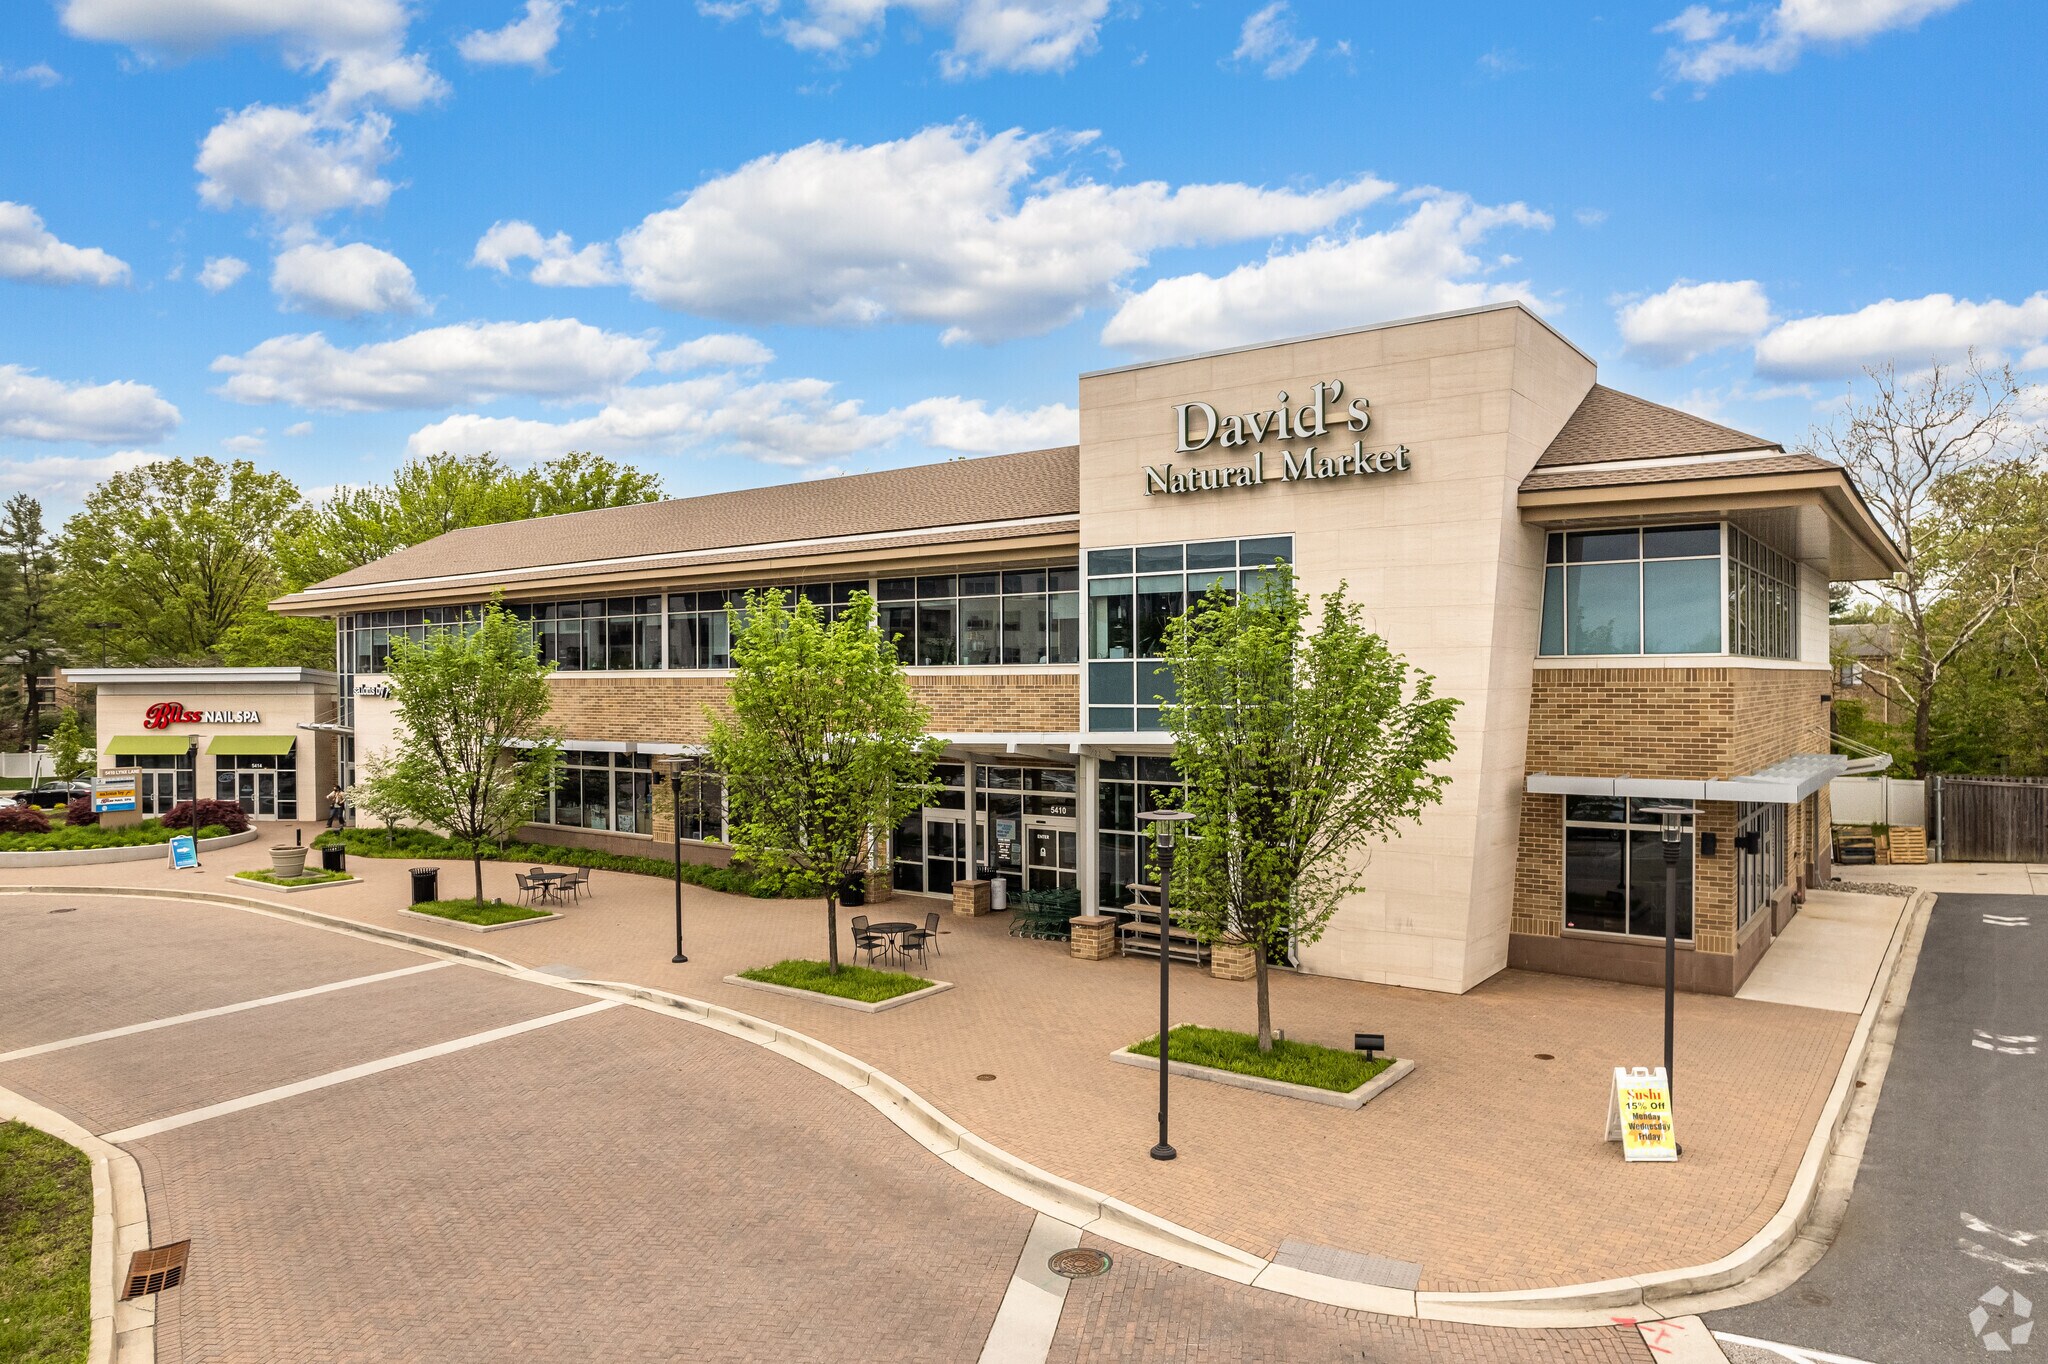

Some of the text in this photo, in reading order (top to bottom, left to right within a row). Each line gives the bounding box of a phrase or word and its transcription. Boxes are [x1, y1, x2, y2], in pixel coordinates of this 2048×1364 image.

[1171, 378, 1371, 454] David's
[1142, 440, 1411, 497] Natural Market
[144, 701, 260, 729] Bliss NAIL SPA
[1050, 806, 1067, 815] 5410
[1627, 1088, 1661, 1100] Sushi
[1626, 1102, 1665, 1110] 15% Off
[1632, 1112, 1661, 1121] Monday
[1628, 1122, 1671, 1131] Wednesday
[1638, 1132, 1661, 1141] Friday
